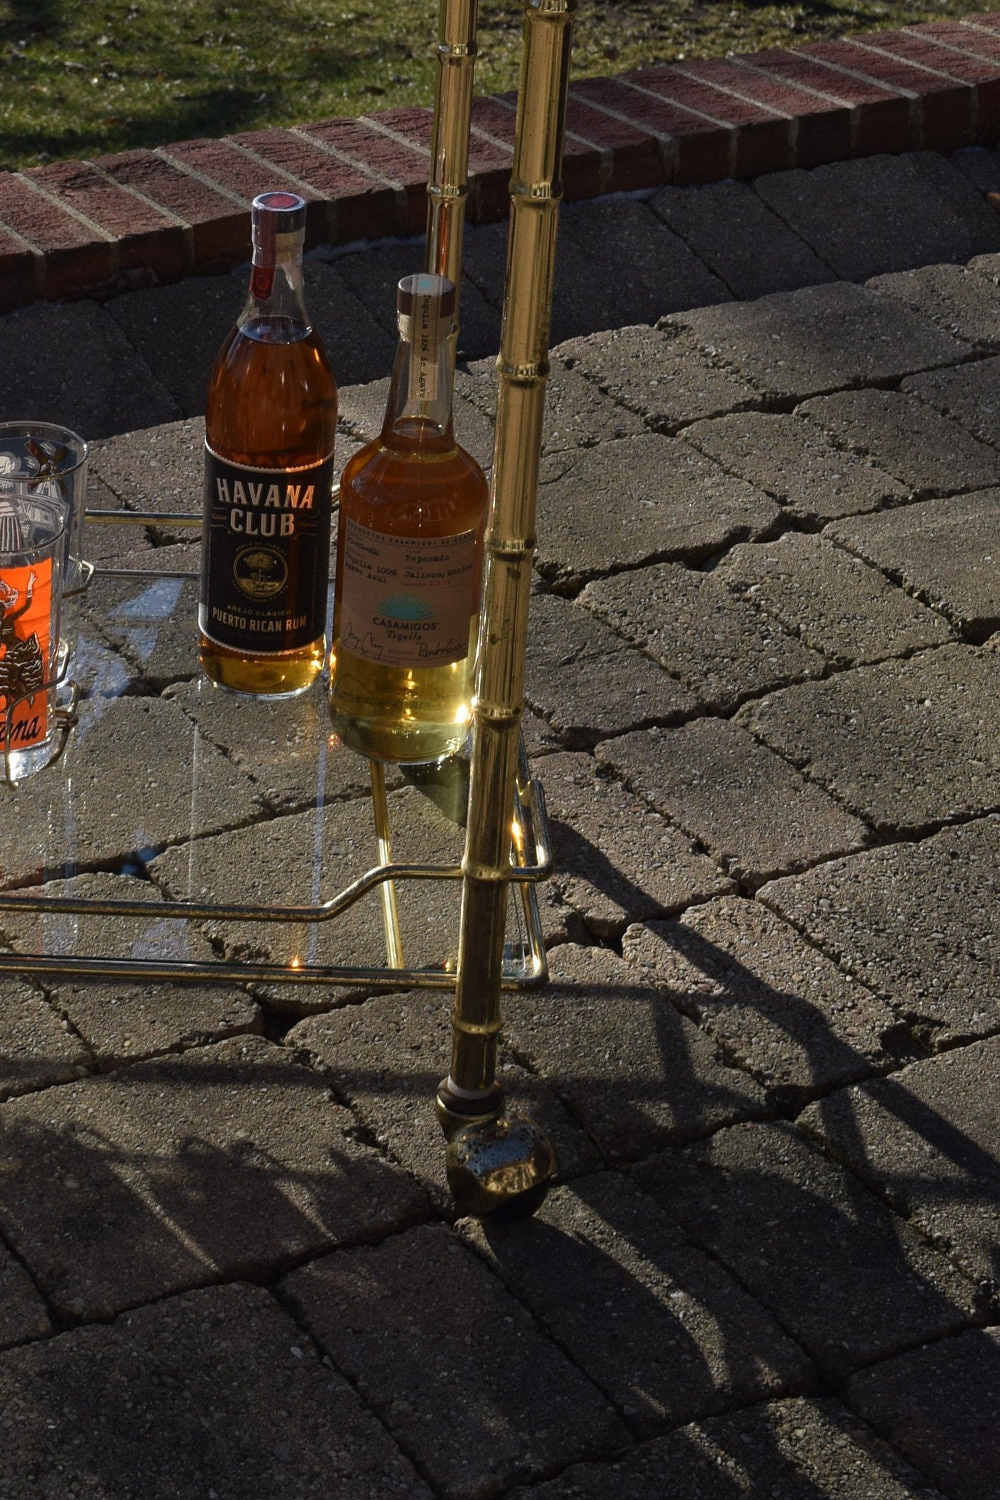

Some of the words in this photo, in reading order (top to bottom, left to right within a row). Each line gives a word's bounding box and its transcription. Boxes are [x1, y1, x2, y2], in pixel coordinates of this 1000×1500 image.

[421, 295, 431, 329] Tequila
[216, 477, 315, 509] HAVANA
[229, 507, 295, 537] CLUB
[405, 554, 449, 563] Reposado
[377, 565, 397, 576] 100%
[212, 606, 246, 629] PUERTO
[249, 619, 282, 632] RICAN
[285, 615, 307, 631] RUM
[373, 617, 438, 631] CASAMIGOS
[386, 630, 422, 642] Tequila
